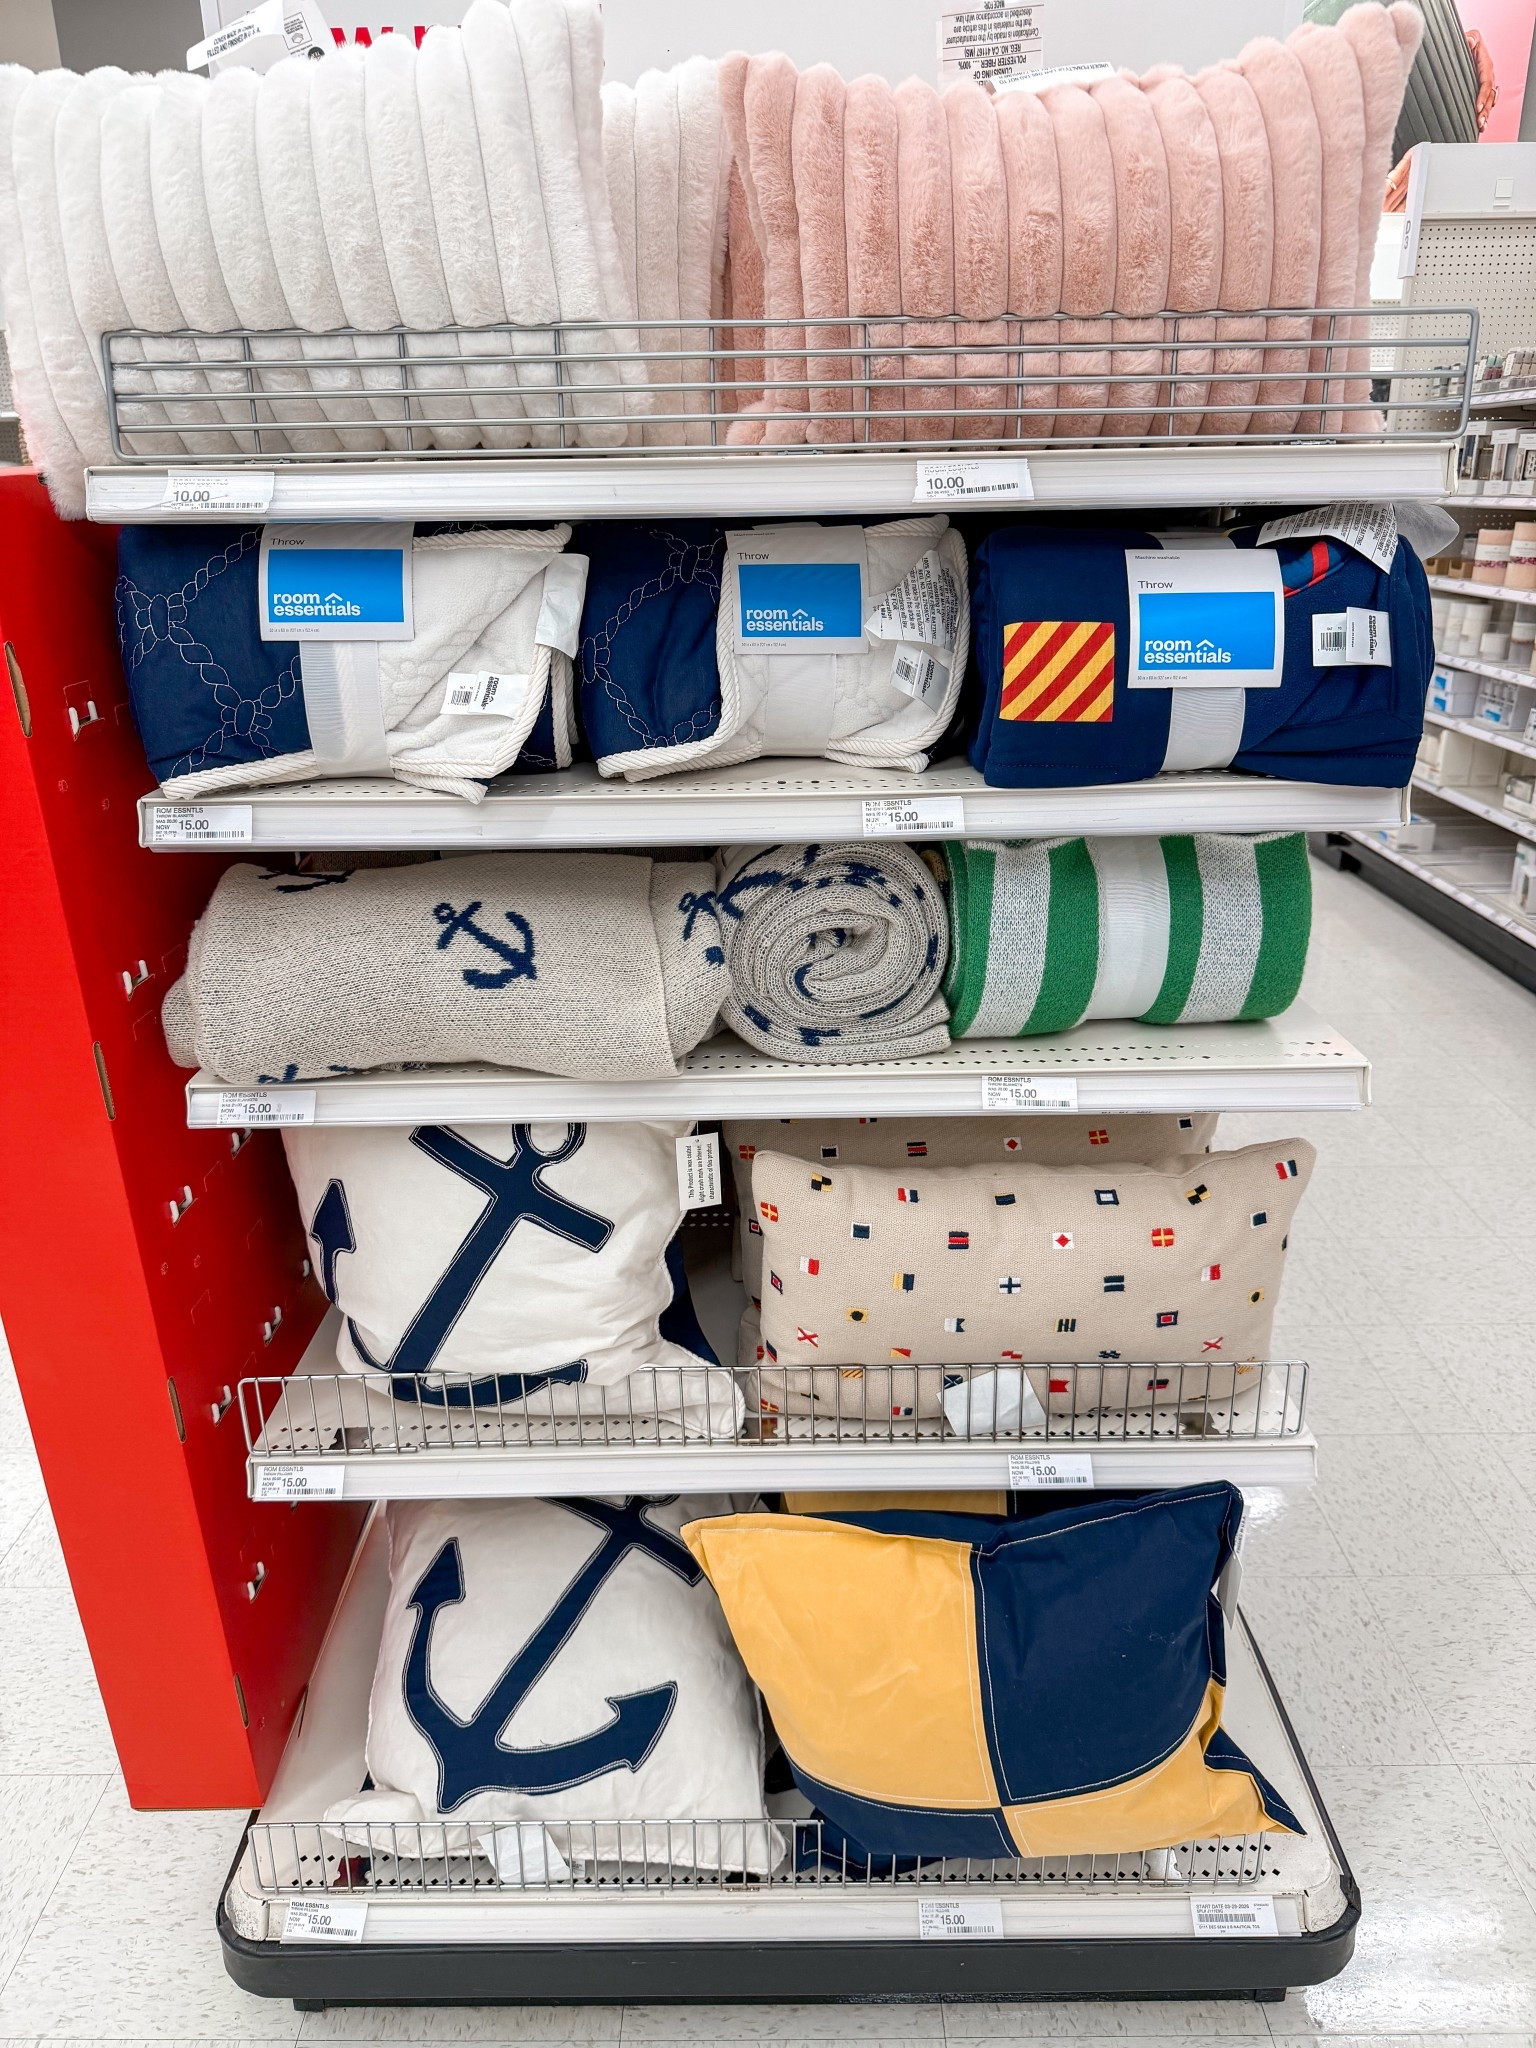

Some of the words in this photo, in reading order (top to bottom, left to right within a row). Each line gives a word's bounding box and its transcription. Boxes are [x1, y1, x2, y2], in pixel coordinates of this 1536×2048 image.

[965, 13, 976, 22] with
[976, 10, 1003, 21] accordance
[1010, 8, 1033, 17] described
[977, 23, 988, 32] this
[1013, 27, 1039, 37] Certification
[945, 34, 978, 45] manufacturer
[977, 33, 987, 42] the
[986, 32, 994, 41] by
[994, 31, 1008, 40] made
[991, 46, 1001, 55] CA
[981, 57, 997, 69] FIBER
[997, 55, 1027, 67] POLYESTER
[973, 71, 981, 80] OF
[926, 476, 965, 490] 10.00
[173, 490, 210, 503] 10.00
[270, 537, 306, 546] Throw
[736, 552, 770, 560] Throw
[925, 569, 934, 600] POLYESTER
[1137, 580, 1174, 589] Throw
[273, 592, 321, 605] room
[273, 600, 361, 617] essentials
[745, 608, 789, 620] room
[745, 616, 825, 632] essentials
[1368, 615, 1376, 656] essentials
[1144, 639, 1192, 652] room
[1144, 647, 1232, 664] essentials
[921, 658, 932, 696] essentials
[480, 676, 495, 708] essentials
[490, 677, 500, 696] room
[888, 811, 918, 822] 15.00
[178, 819, 210, 830] 15.00
[1009, 1088, 1037, 1099] 15.00
[242, 1103, 272, 1114] 15.00
[1030, 1466, 1057, 1476] 15.00
[282, 1477, 308, 1487] 15.00
[305, 1902, 330, 1910] ESSNTLS
[307, 1914, 332, 1926] 15.00
[940, 1914, 965, 1926] 15.00
